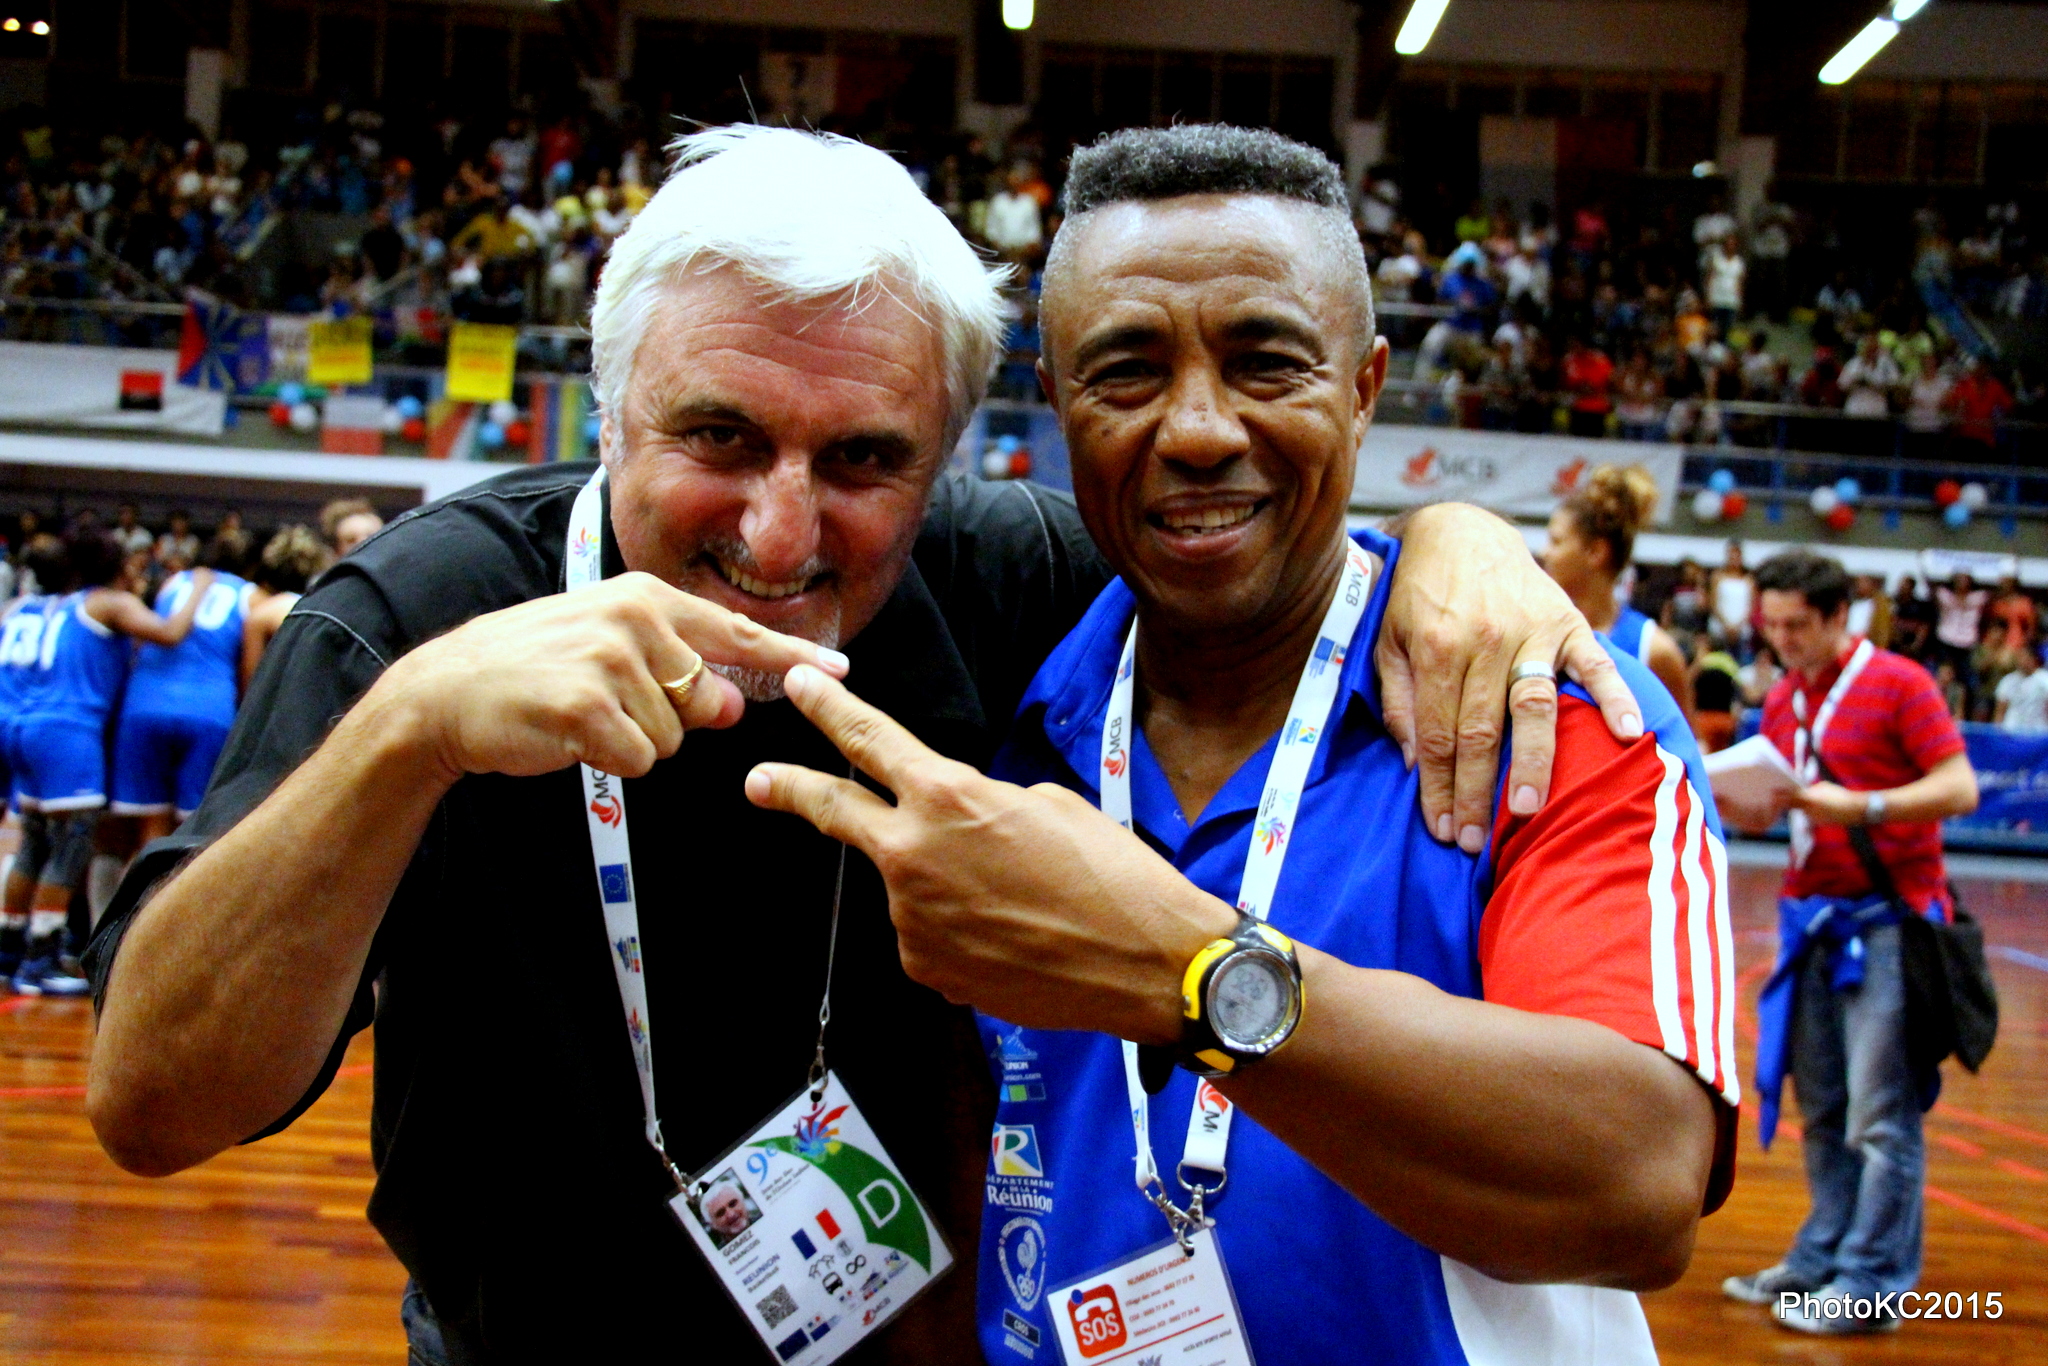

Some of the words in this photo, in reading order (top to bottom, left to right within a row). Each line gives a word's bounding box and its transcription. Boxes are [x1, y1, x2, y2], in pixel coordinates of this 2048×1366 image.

[1345, 569, 1363, 607] MCB
[1109, 716, 1122, 755] MCB
[592, 769, 610, 799] MC
[857, 1178, 901, 1229] D
[987, 1184, 1053, 1213] Réunion
[1079, 1313, 1121, 1346] SOS
